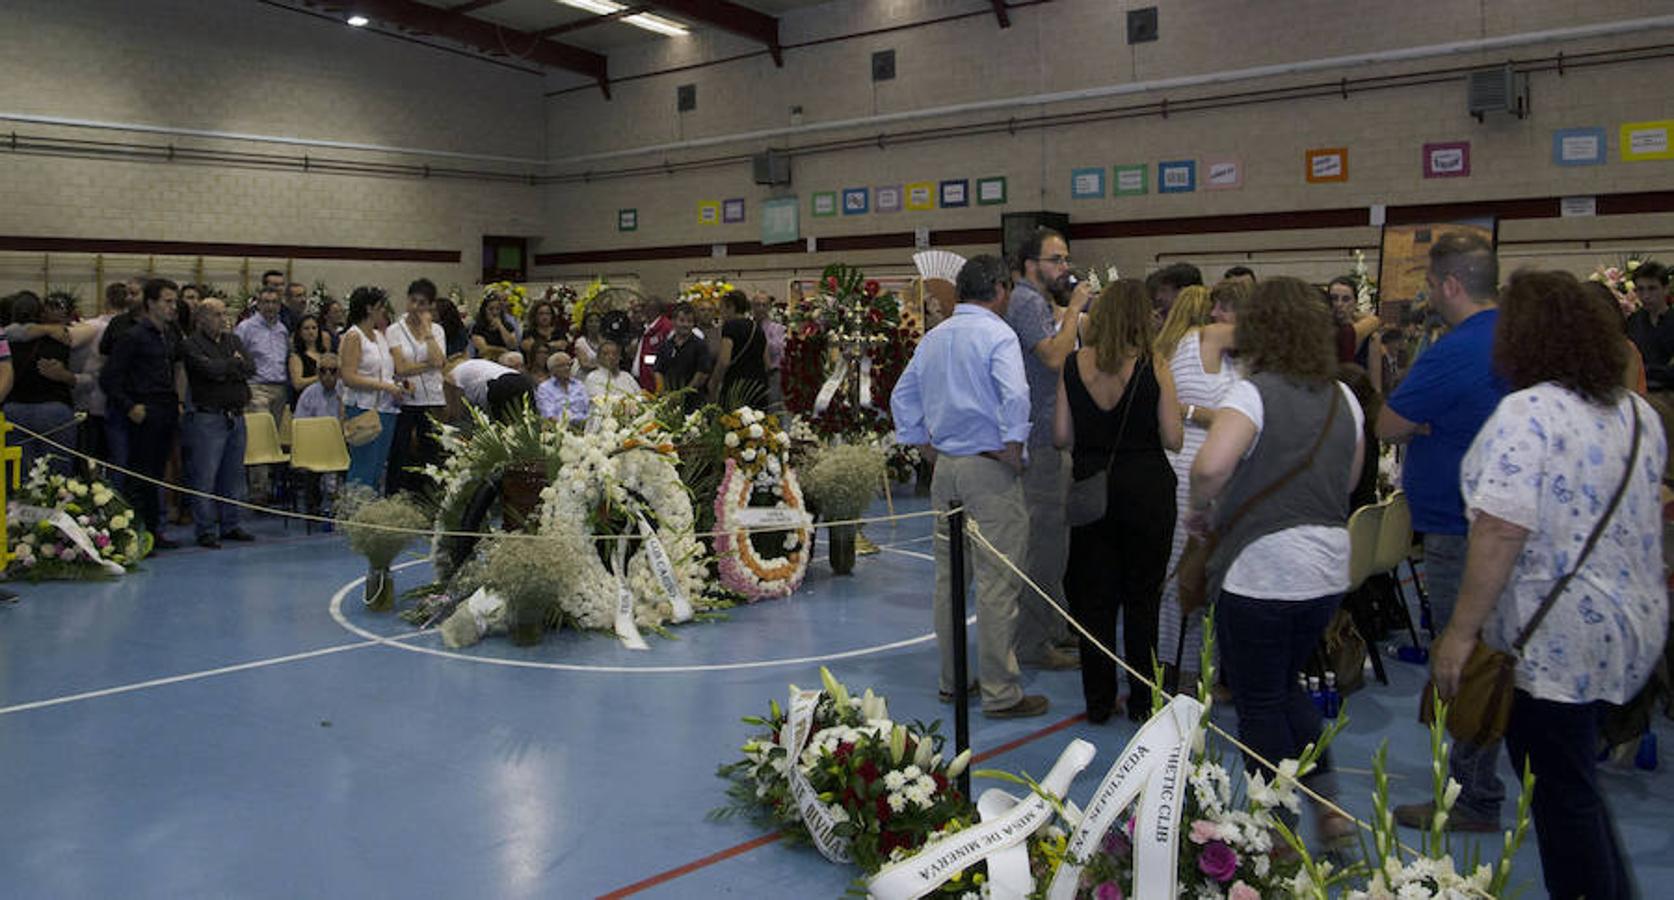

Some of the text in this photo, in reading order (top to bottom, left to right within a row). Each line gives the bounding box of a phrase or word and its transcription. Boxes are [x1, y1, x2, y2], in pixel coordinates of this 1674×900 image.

[1089, 744, 1150, 822] SEPULVEDA
[983, 832, 1002, 845] DE
[918, 842, 981, 880] MINERVA
